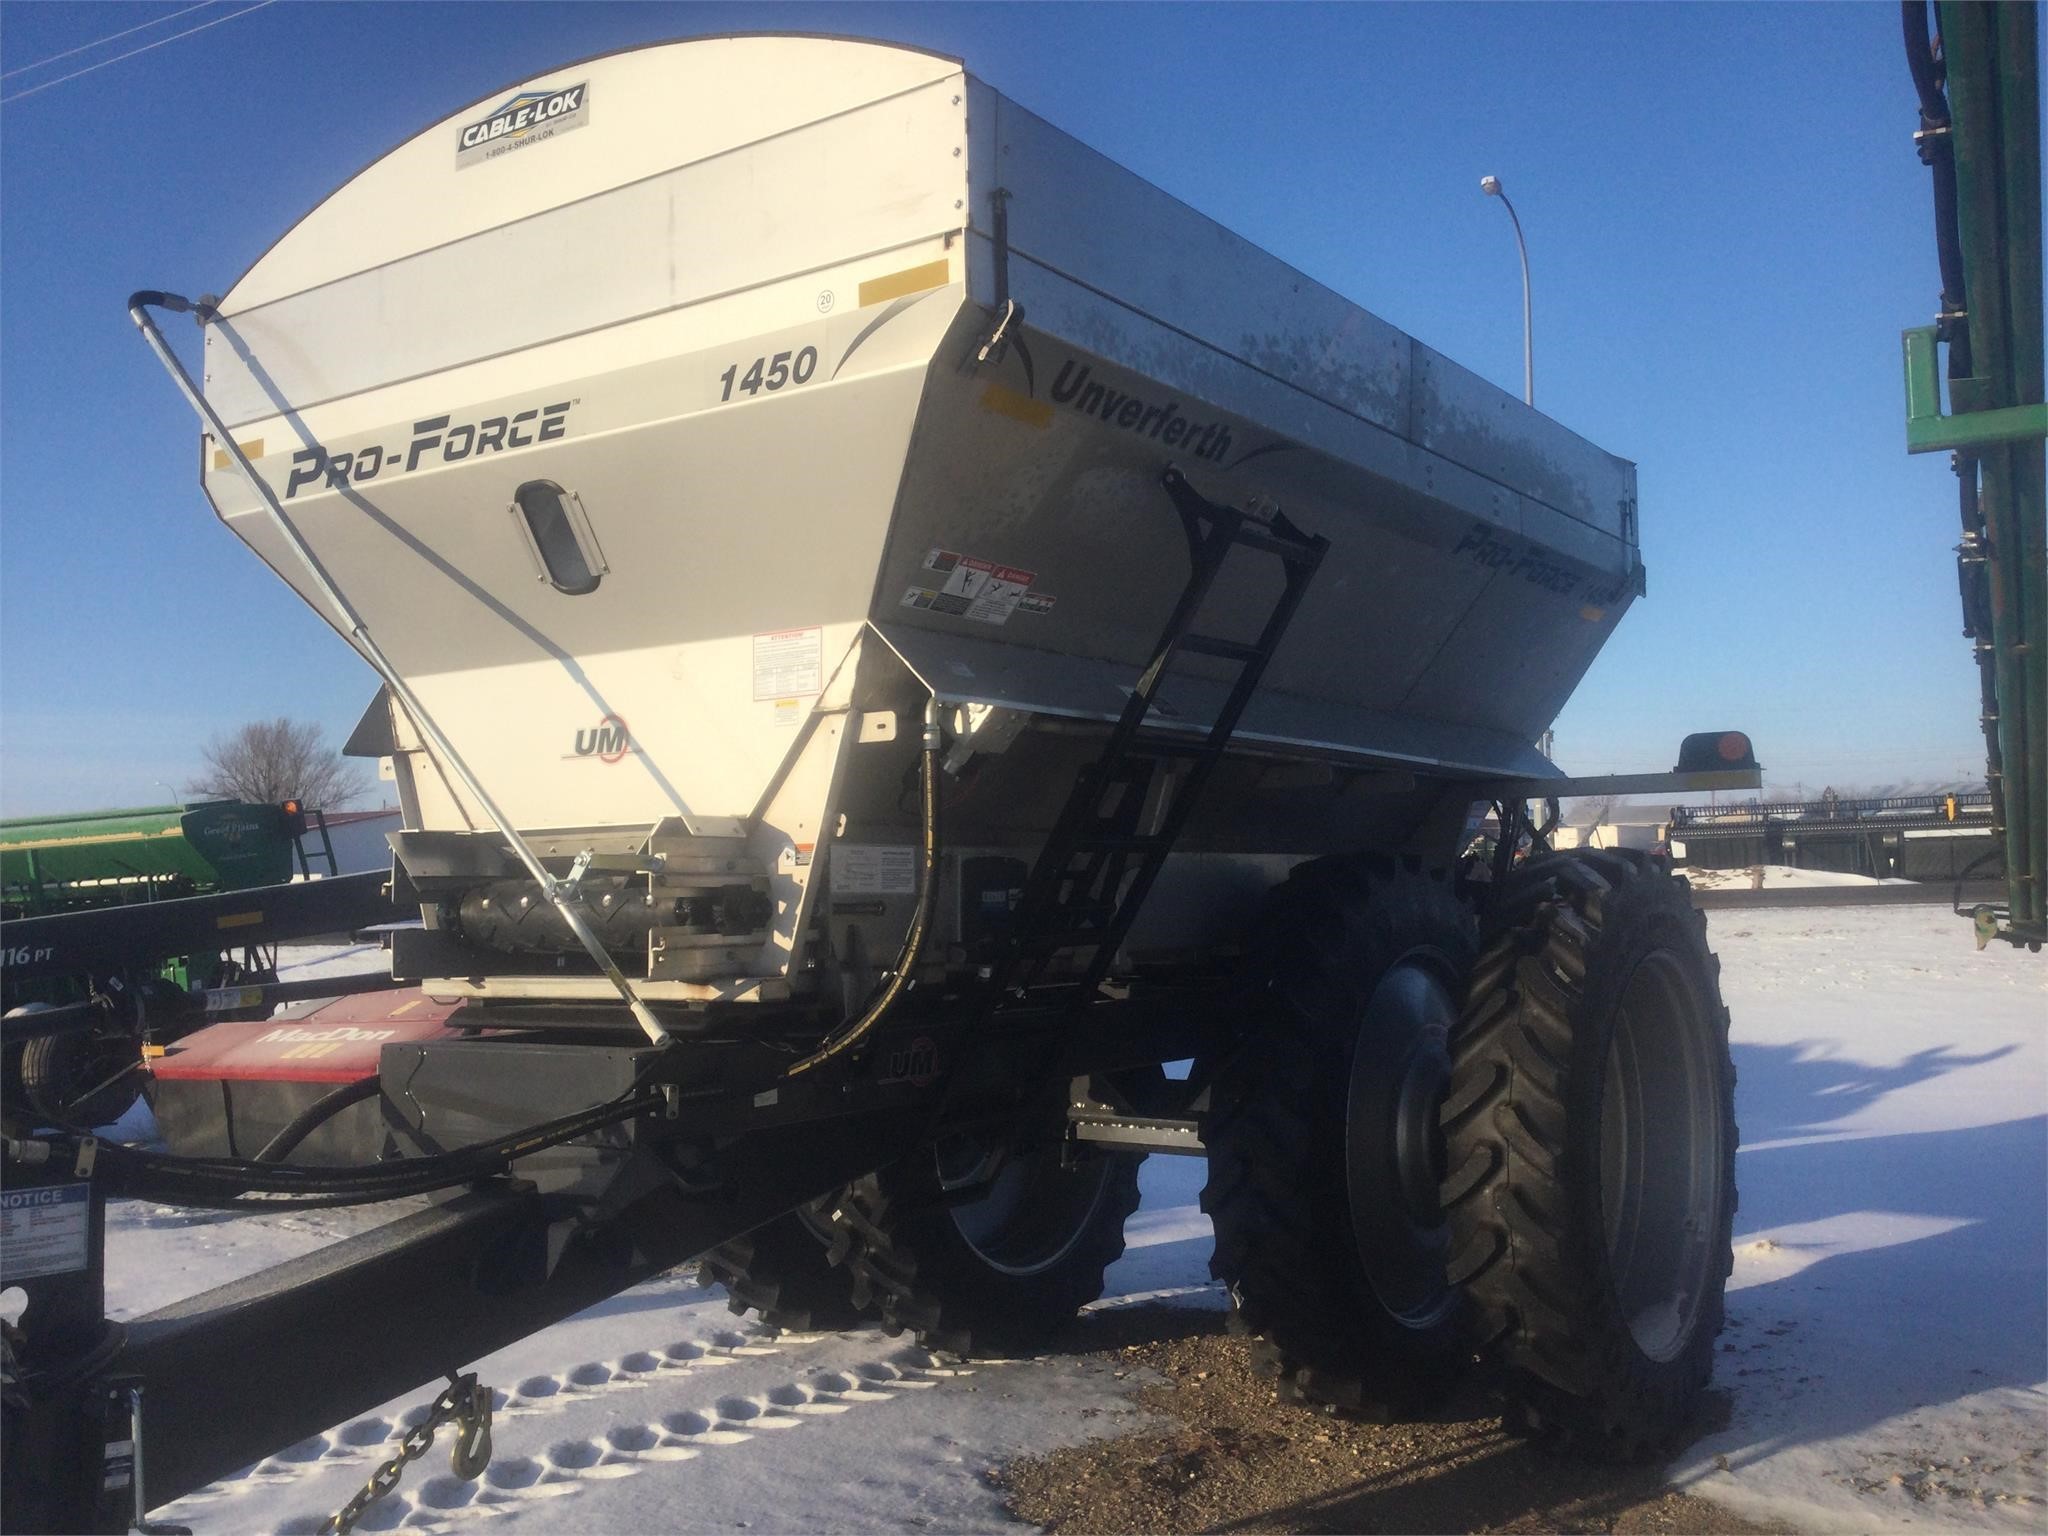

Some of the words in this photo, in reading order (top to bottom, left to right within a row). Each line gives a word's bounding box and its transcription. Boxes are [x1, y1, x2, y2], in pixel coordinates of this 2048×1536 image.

[462, 89, 580, 148] CABLE-LOK
[820, 293, 831, 306] 20
[719, 346, 818, 402] 1450
[1051, 360, 1233, 462] Unverferth
[575, 726, 625, 756] UM
[34, 947, 54, 962] PT
[256, 1027, 396, 1044] MacDon
